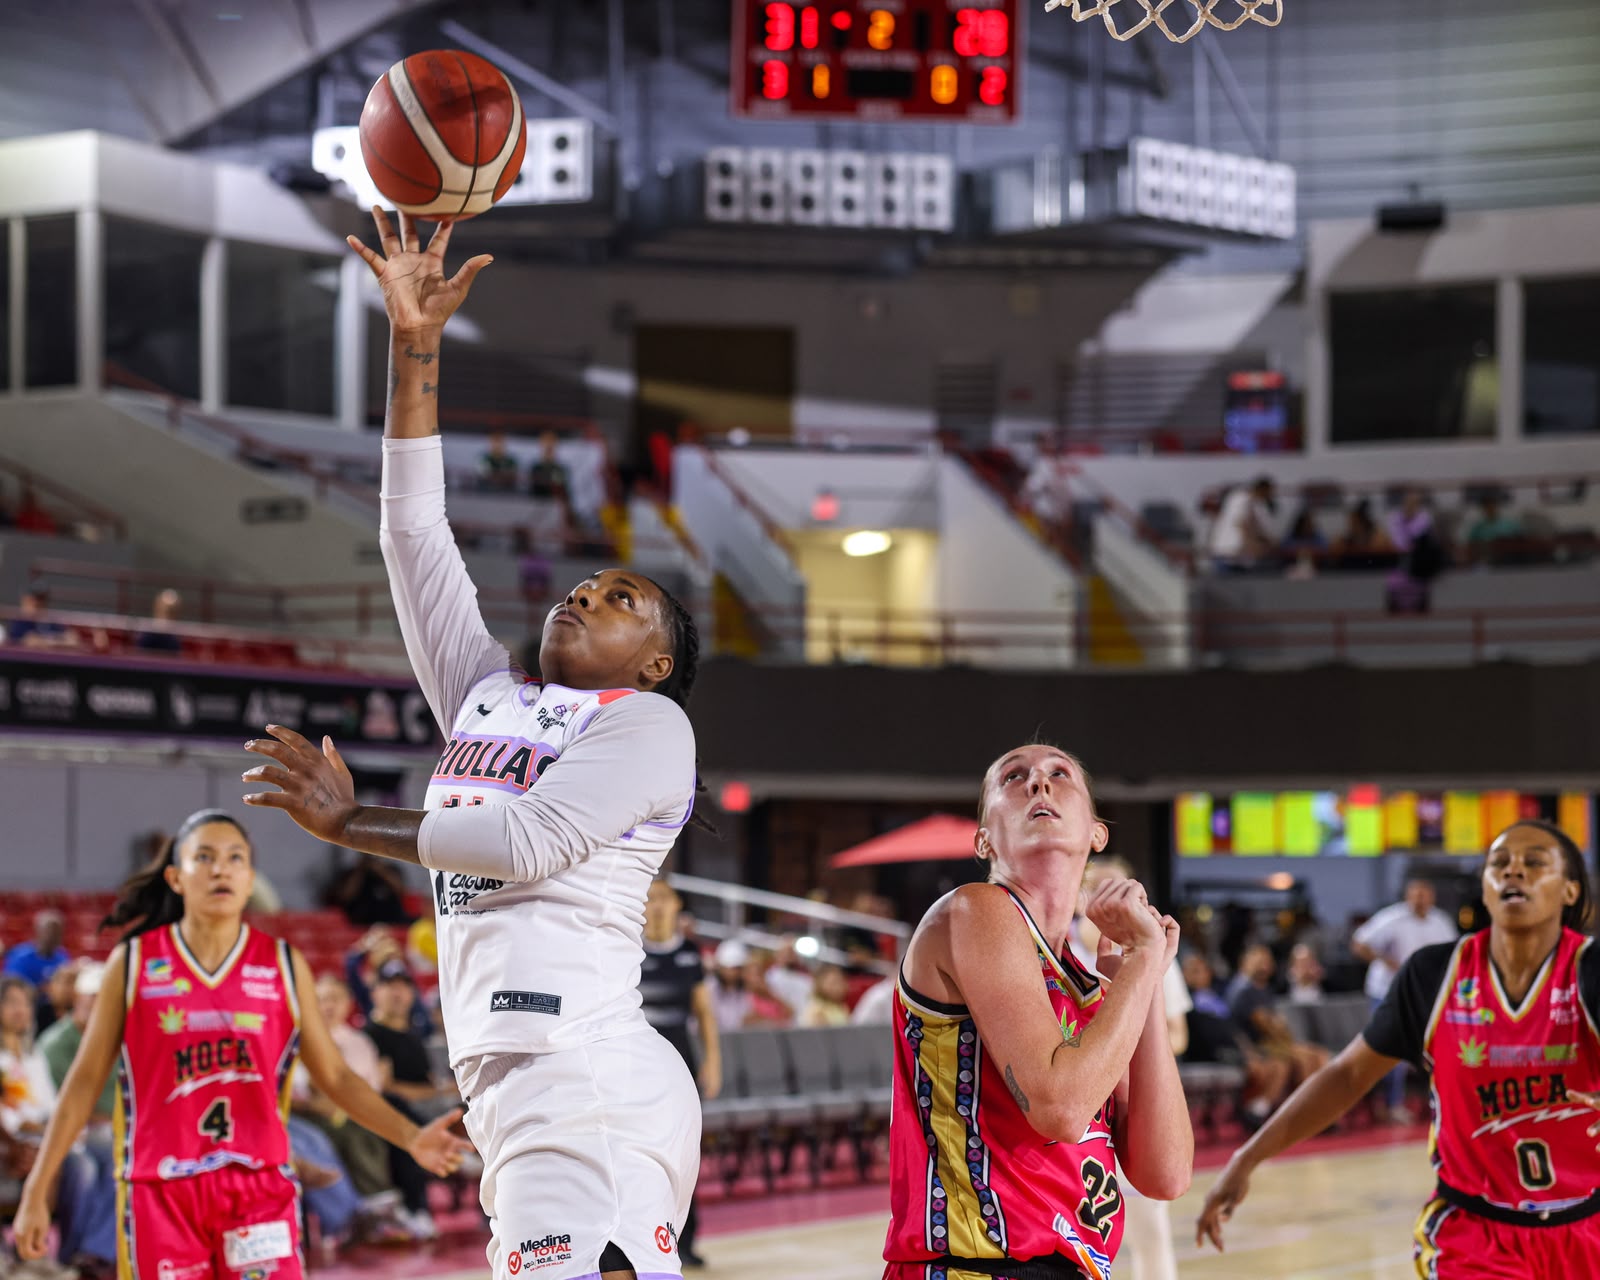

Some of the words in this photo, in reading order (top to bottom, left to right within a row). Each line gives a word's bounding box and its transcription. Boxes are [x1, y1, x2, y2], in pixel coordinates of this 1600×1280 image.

[867, 9, 895, 50] 2
[763, 59, 788, 100] 3
[173, 1038, 255, 1081] MOCA
[1477, 1074, 1568, 1119] MOCA
[200, 1098, 232, 1143] 4
[1514, 1138, 1556, 1191] 0
[520, 1233, 571, 1254] Medina
[532, 1243, 572, 1258] TOTAL
